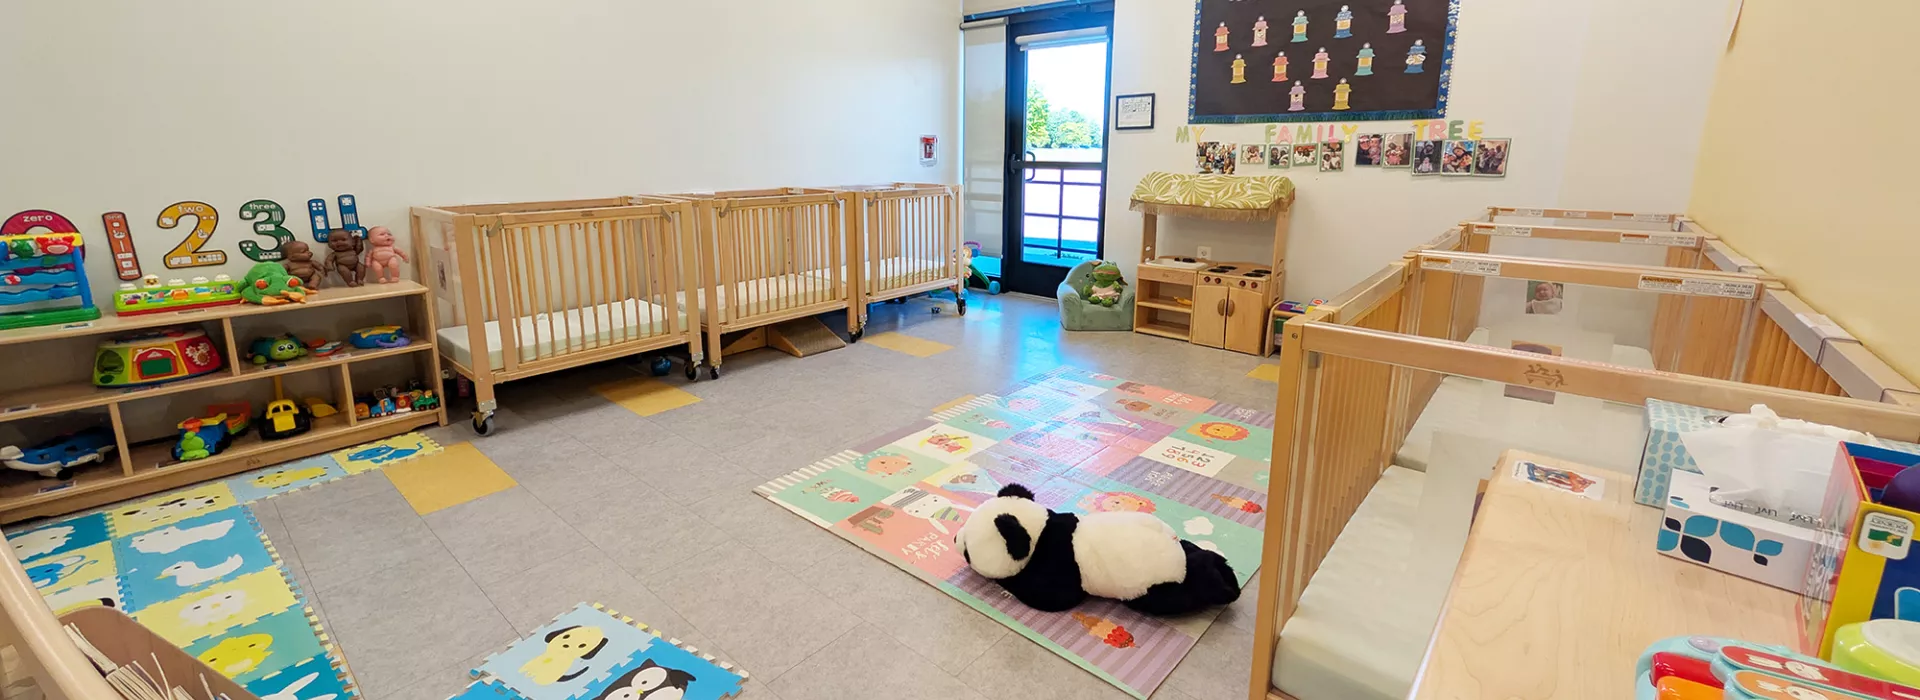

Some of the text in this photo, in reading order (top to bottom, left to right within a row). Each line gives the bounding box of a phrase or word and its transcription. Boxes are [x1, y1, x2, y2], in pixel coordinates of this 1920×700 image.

[1176, 119, 1485, 144] MY FAMILY TREE
[178, 204, 204, 214] two
[249, 202, 276, 211] three
[23, 214, 53, 223] zero
[156, 200, 227, 269] 2
[239, 199, 296, 262] 3
[318, 232, 328, 240] fo
